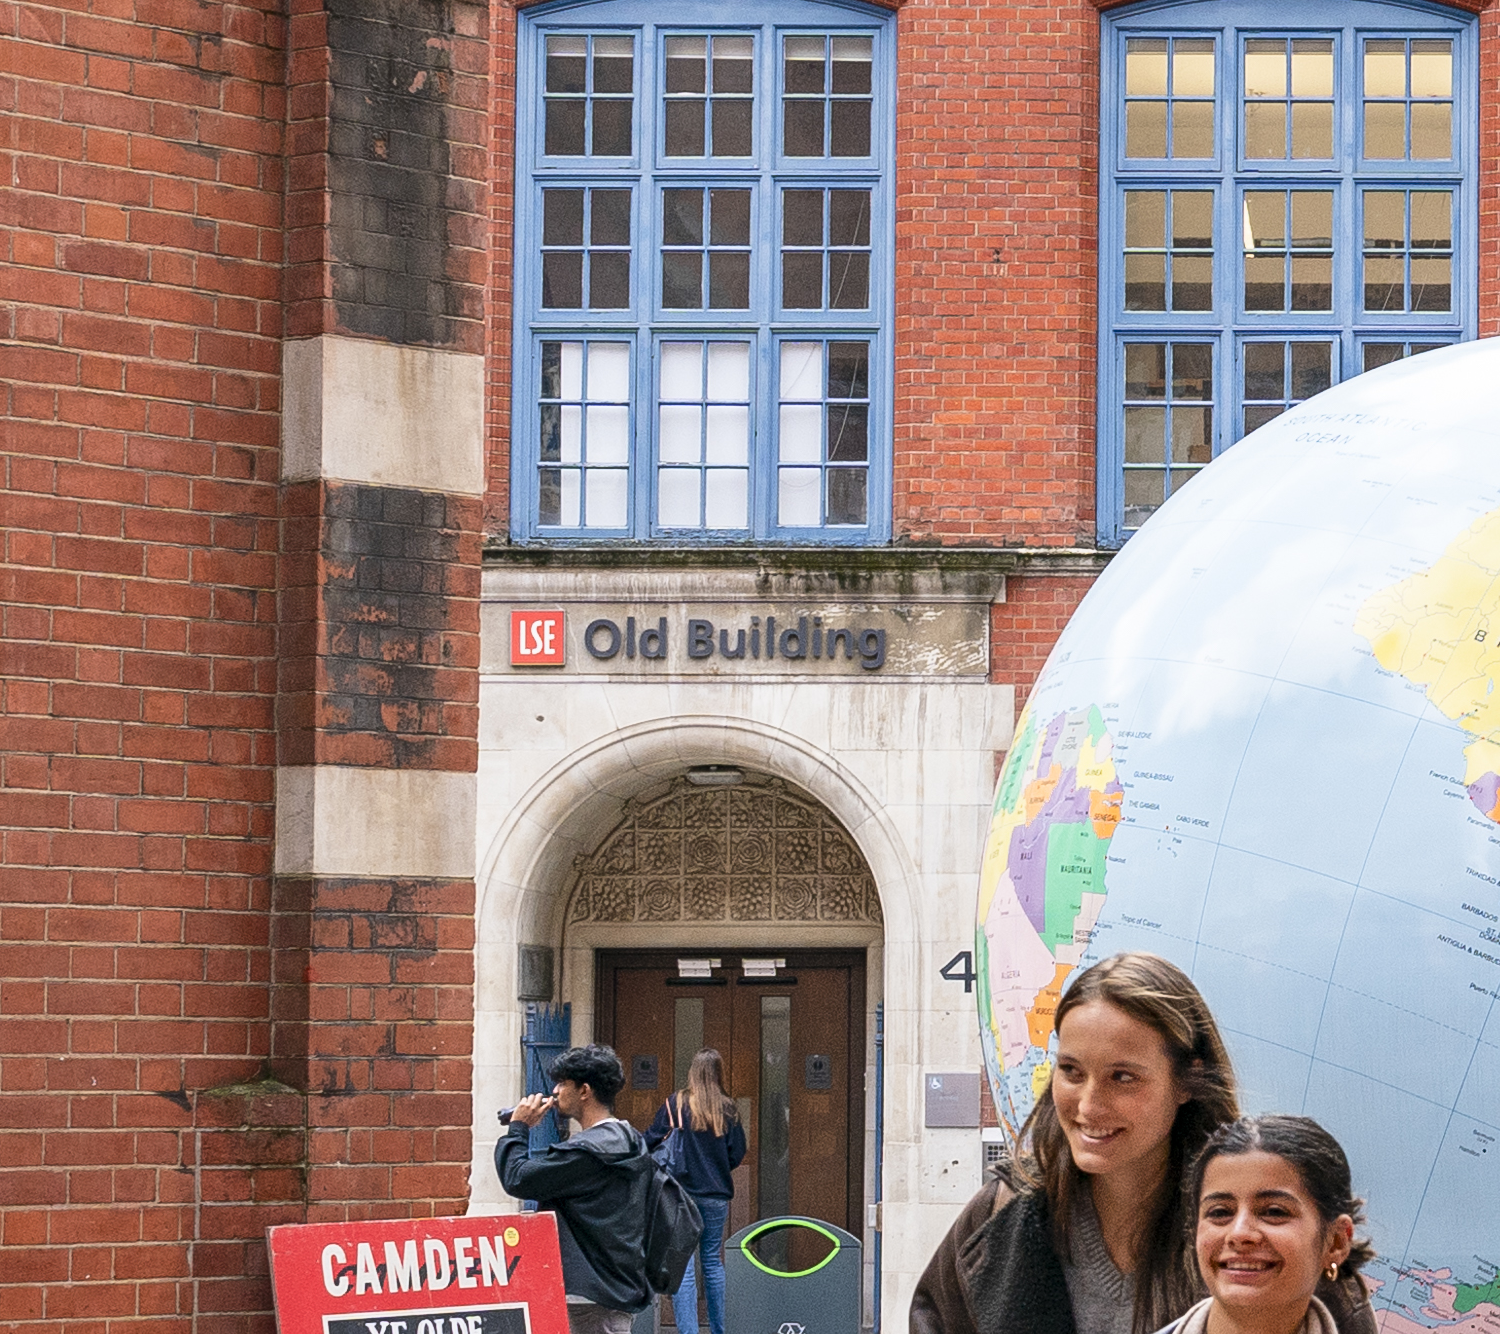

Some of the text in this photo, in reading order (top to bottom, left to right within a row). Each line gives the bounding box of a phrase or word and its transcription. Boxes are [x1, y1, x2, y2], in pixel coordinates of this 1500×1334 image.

[1295, 432, 1355, 445] OCEAN
[518, 616, 887, 668] LSE Old Building
[1465, 867, 1496, 885] TRINIDAD
[1461, 903, 1499, 923] BARBADOS
[1437, 934, 1467, 951] ANTIGUA
[939, 950, 977, 993] 4
[321, 1235, 509, 1298] CAMDEN
